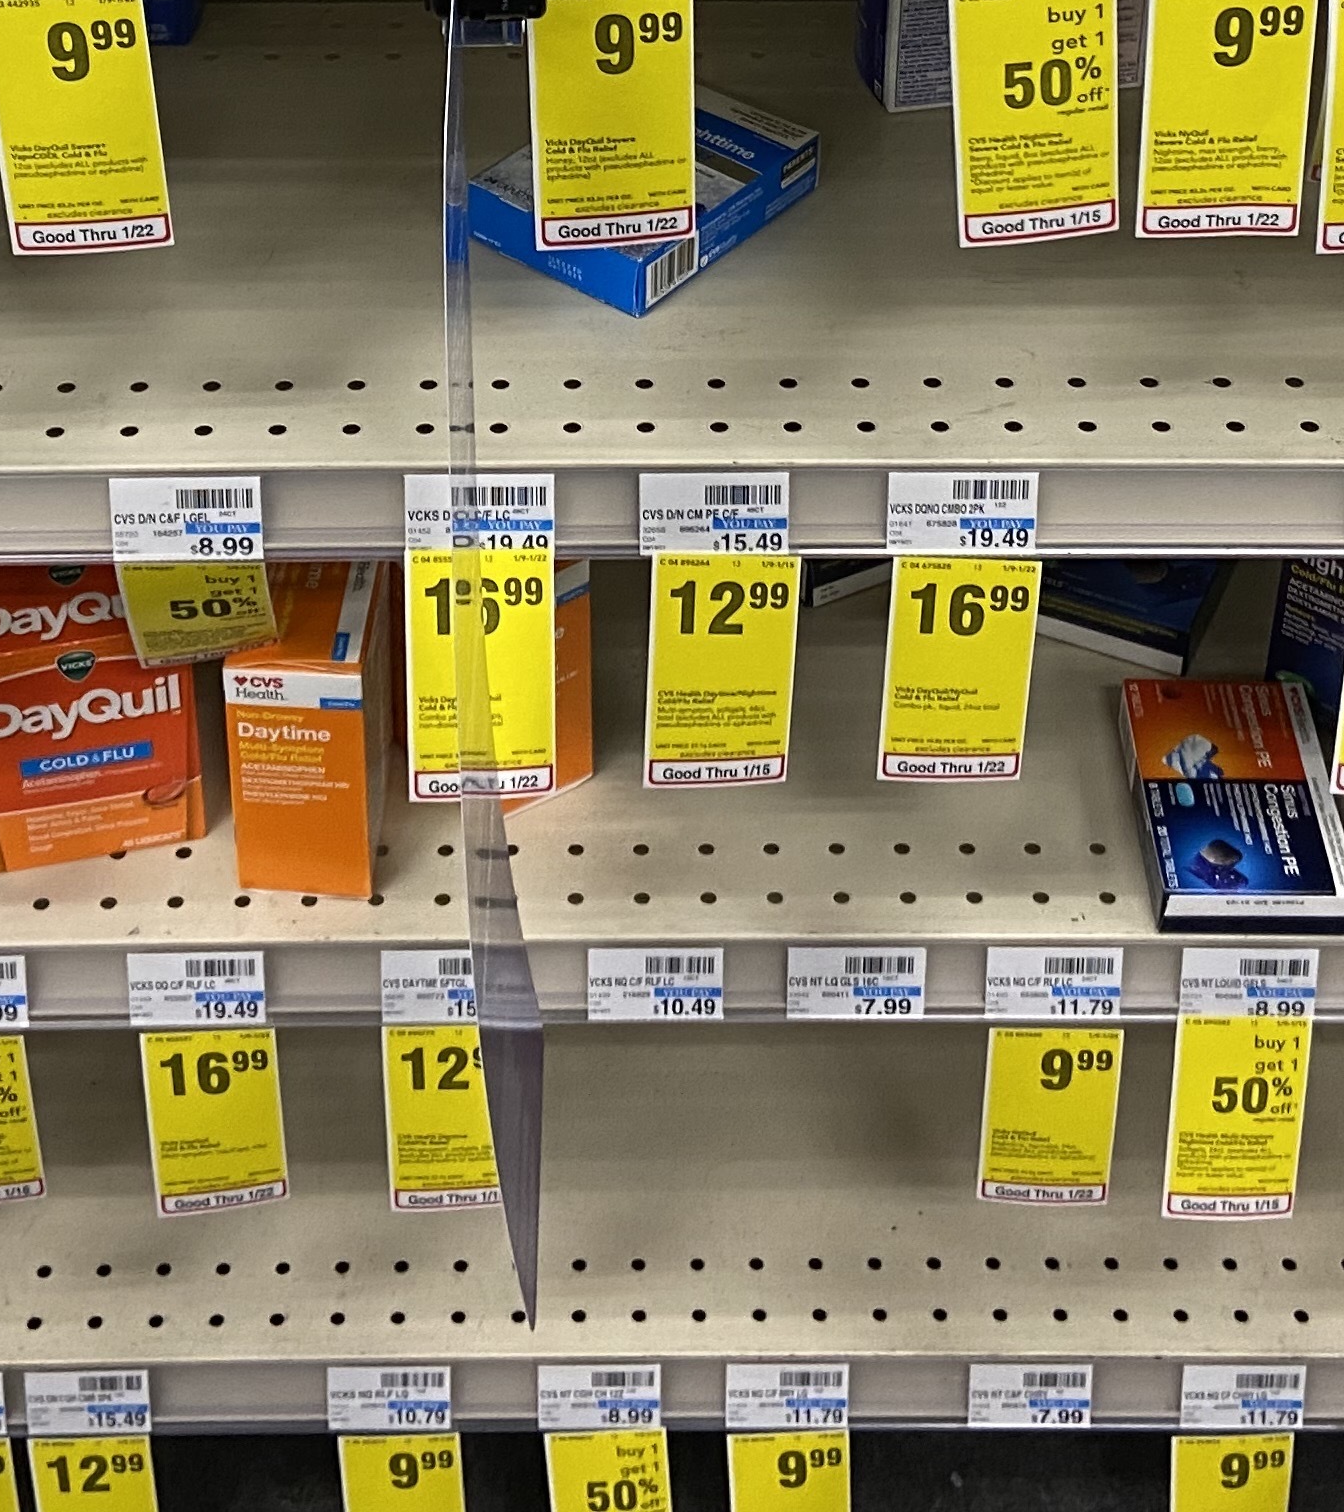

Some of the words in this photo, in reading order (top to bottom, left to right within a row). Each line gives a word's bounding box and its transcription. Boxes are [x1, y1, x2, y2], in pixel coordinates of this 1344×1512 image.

[558, 223, 601, 241] Good
[605, 222, 641, 238] Thru
[647, 217, 678, 233] 1/22
[190, 537, 253, 555] $8.99
[960, 525, 1033, 547] $19.49
[61, 658, 92, 670] VICKS
[250, 677, 284, 688] CVS
[236, 688, 284, 700] Health
[238, 722, 331, 742] Daytime
[40, 756, 88, 772] COLD
[103, 747, 135, 762] FLU
[893, 761, 938, 778] Good
[940, 762, 972, 773] Thru
[979, 761, 1005, 773] 1/22
[1281, 784, 1299, 819] Sinus
[1282, 856, 1299, 877] PE
[195, 996, 262, 1018] $19.49
[87, 1407, 148, 1427] $15.49
[599, 1404, 657, 1424] $8.99
[1241, 1405, 1303, 1425] $11.79
